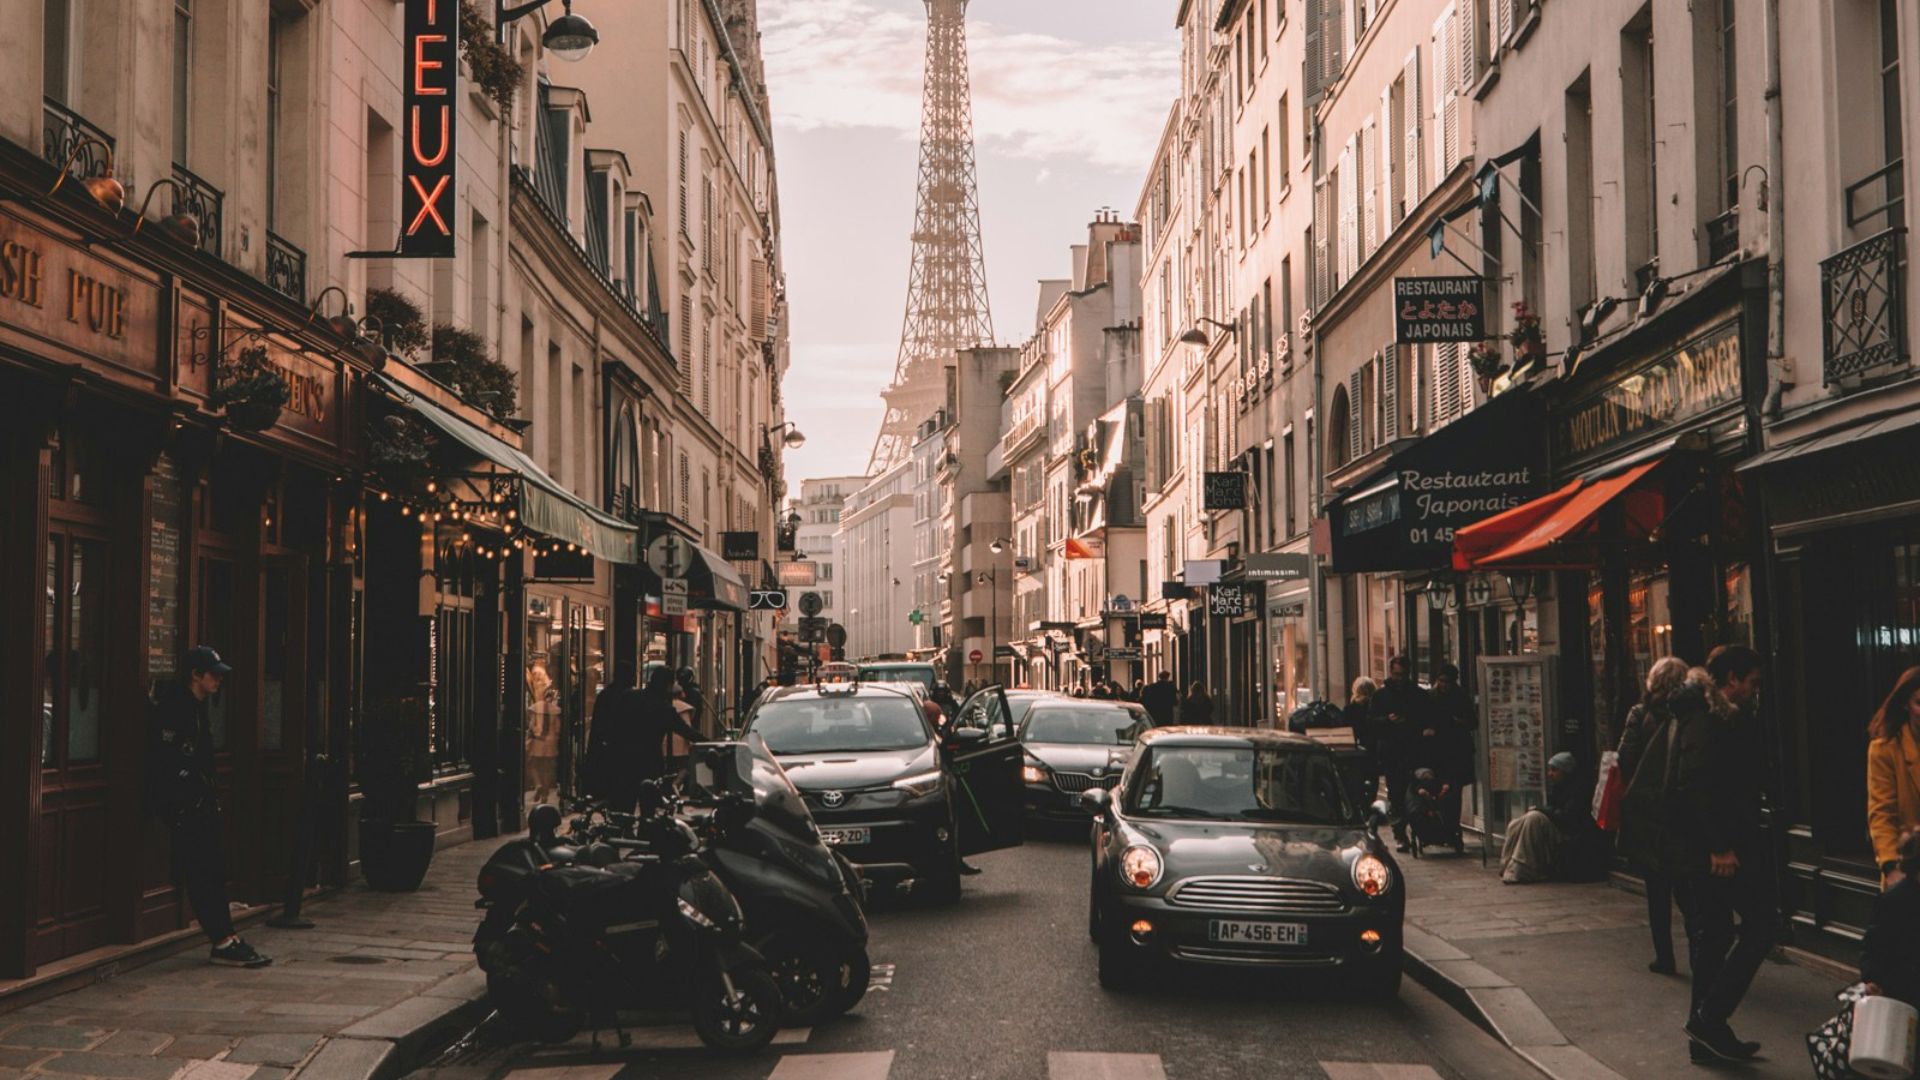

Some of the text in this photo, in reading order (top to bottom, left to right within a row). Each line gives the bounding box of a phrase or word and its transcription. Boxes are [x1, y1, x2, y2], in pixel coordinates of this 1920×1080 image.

[1397, 281, 1478, 295] RESTAURANT
[66, 267, 129, 342] PUB
[1401, 300, 1477, 320] とよたか
[1405, 323, 1473, 338] JAPONAIS
[1570, 396, 1620, 450] MOULIN
[1624, 388, 1646, 432] DE
[1649, 374, 1673, 420] LA
[1676, 335, 1741, 409] VIERGE
[1211, 475, 1241, 488] Karl
[1402, 467, 1530, 491] Restaurant
[1206, 485, 1241, 497] Marc
[1206, 495, 1242, 506] John
[1416, 493, 1519, 520] Japonais
[1410, 527, 1455, 543] 01 45
[1216, 585, 1241, 597] Karl
[1211, 595, 1242, 605] Marc
[1211, 604, 1242, 614] John
[1221, 923, 1297, 942] AP-456-EH
